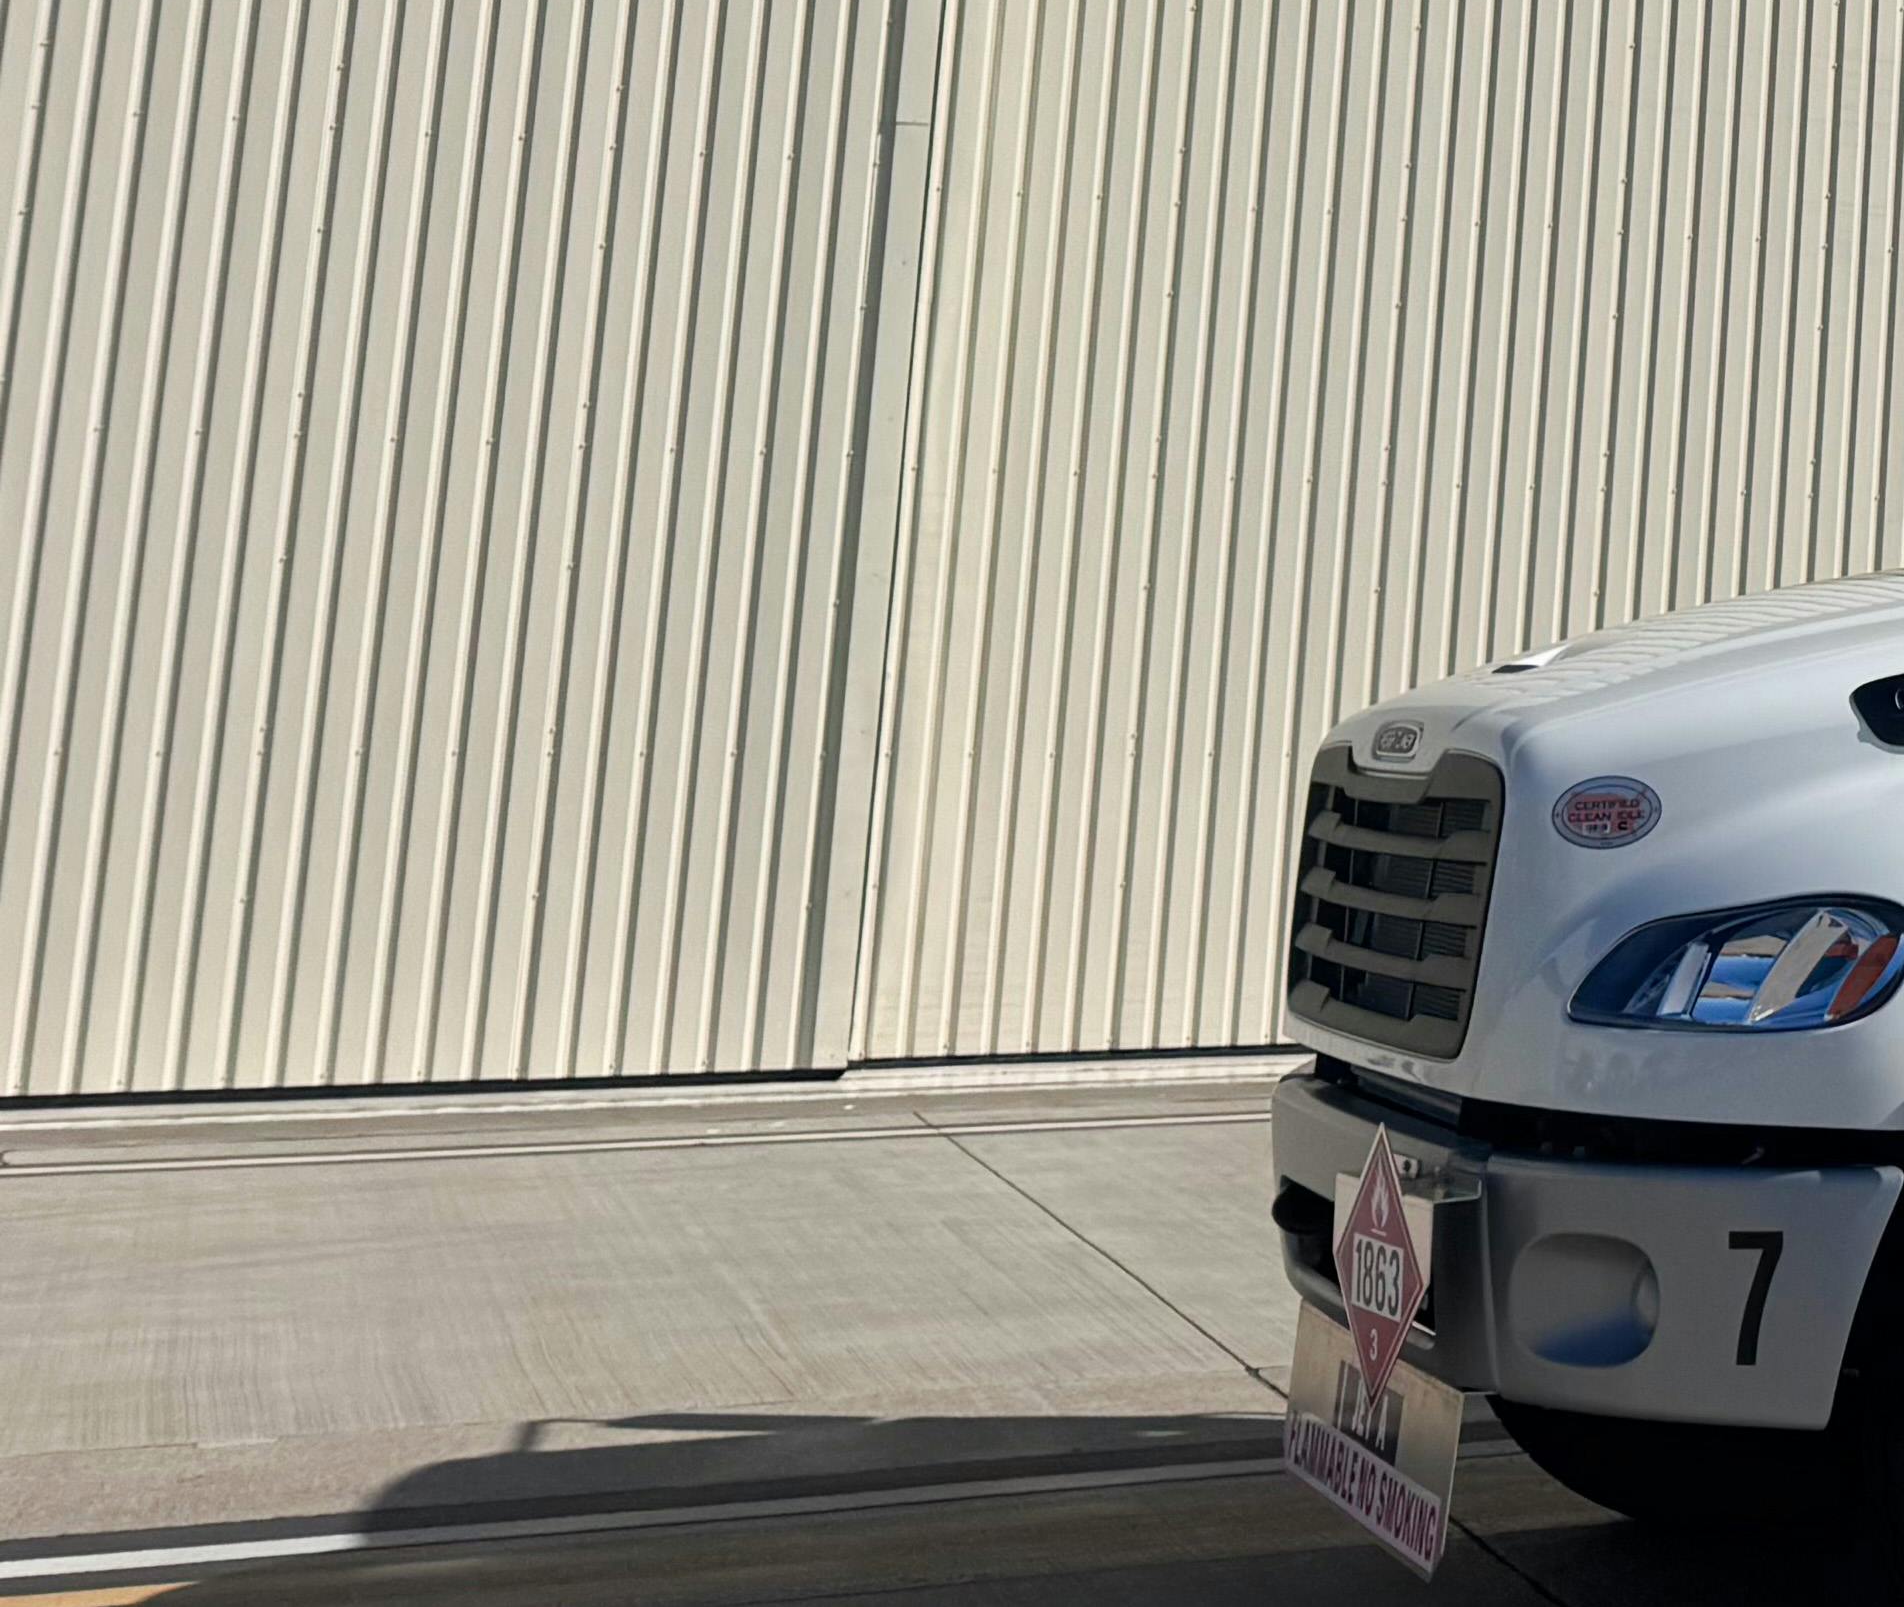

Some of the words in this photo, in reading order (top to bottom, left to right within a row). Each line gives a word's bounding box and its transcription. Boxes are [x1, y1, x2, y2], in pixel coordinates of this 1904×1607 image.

[1354, 1238, 1401, 1318] 1863
[1728, 1231, 1784, 1366] 7
[1369, 1328, 1379, 1361] 3
[1287, 1410, 1358, 1504] FLAMMABLE
[1358, 1456, 1376, 1517] NO
[1375, 1470, 1437, 1562] SMOKING
